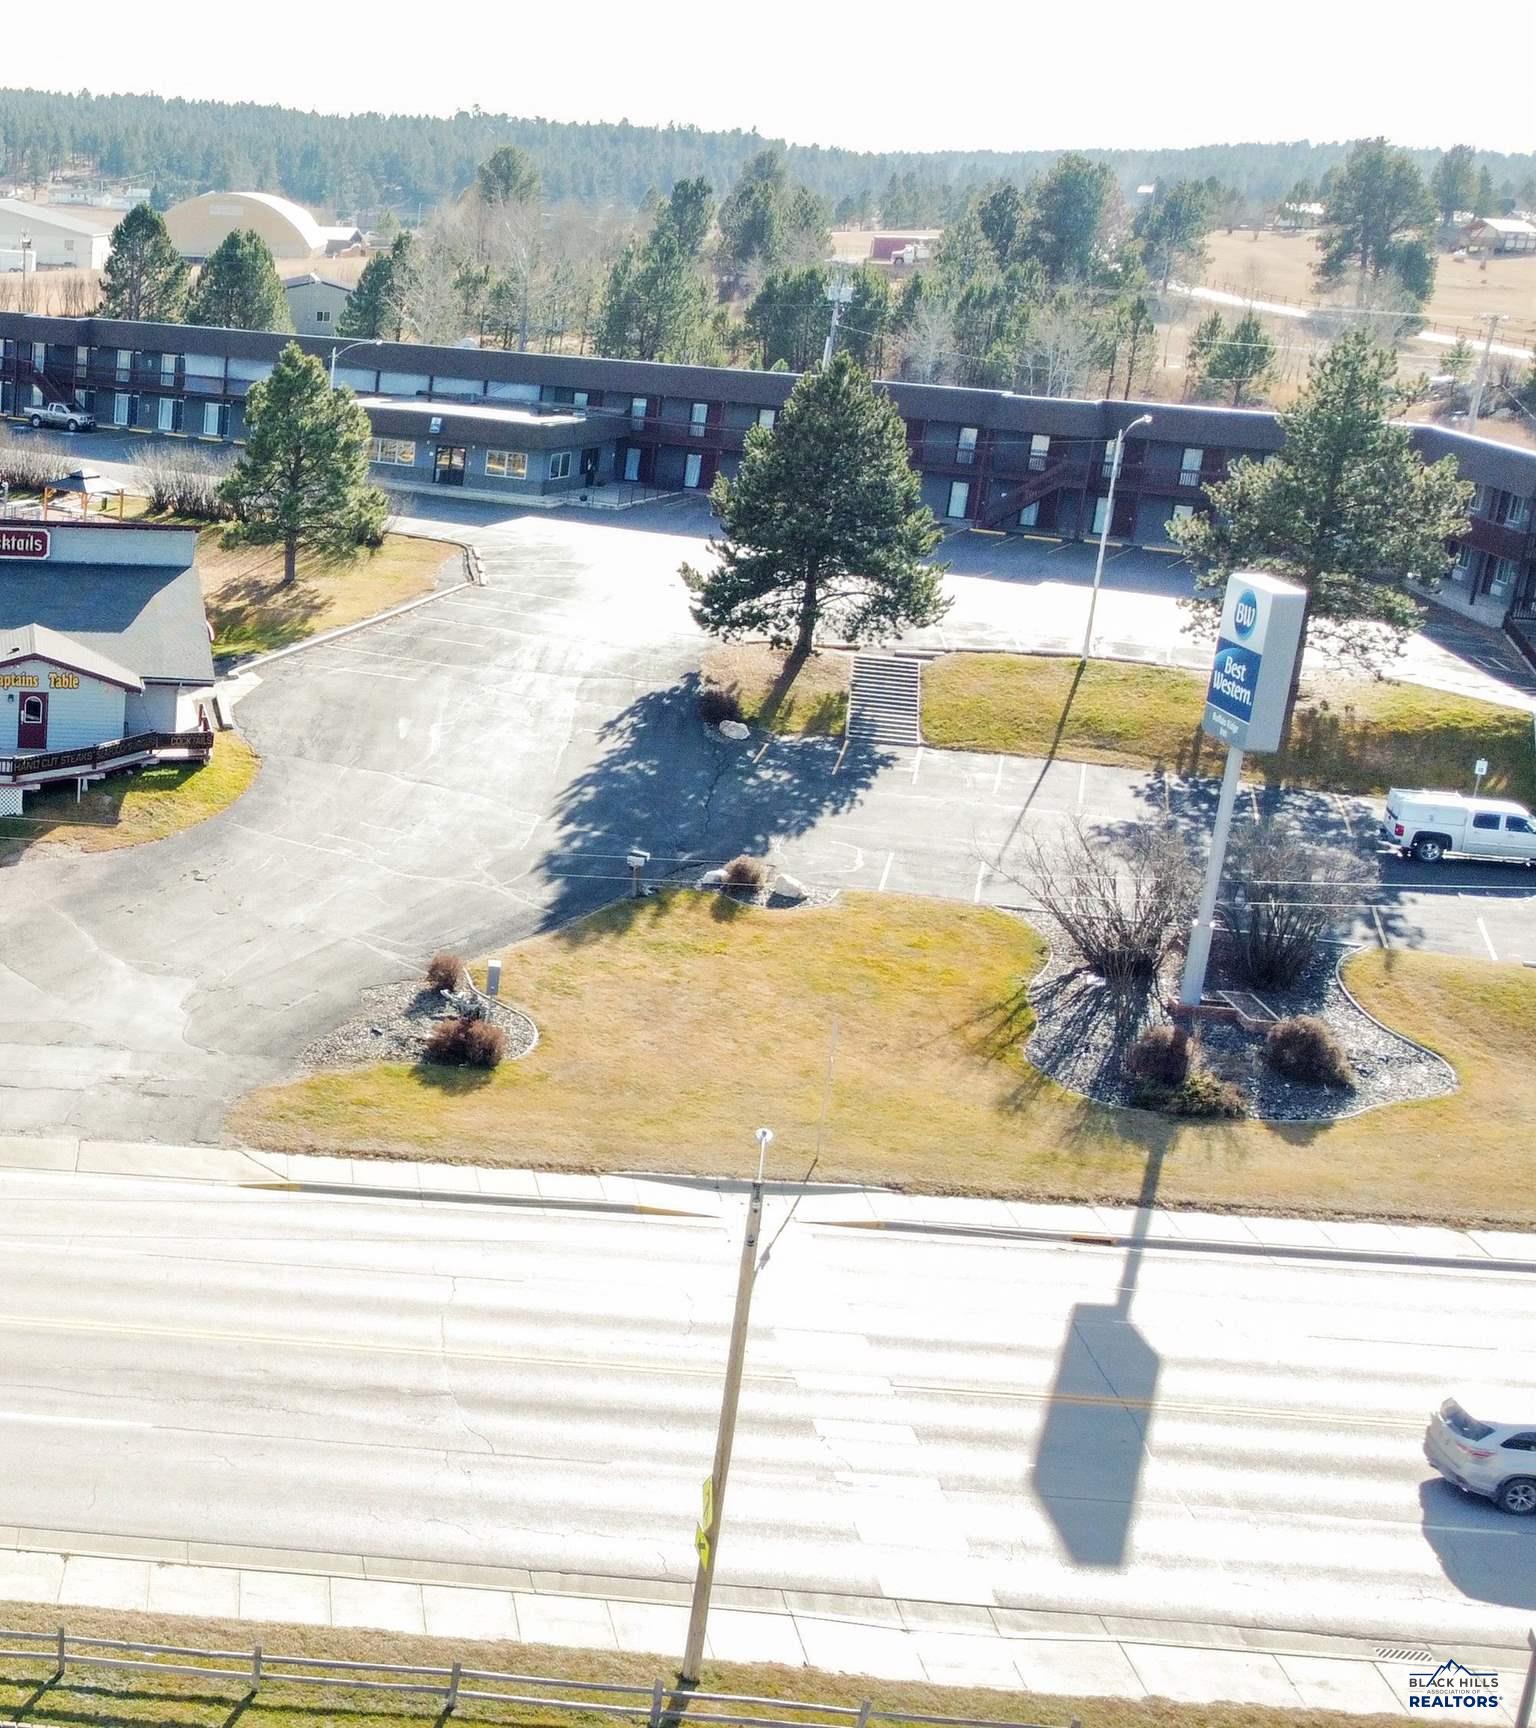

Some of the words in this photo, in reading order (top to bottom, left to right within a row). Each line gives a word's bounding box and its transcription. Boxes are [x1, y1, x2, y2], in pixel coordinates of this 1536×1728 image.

[1235, 602, 1256, 628] BW
[48, 672, 80, 689] Table
[1224, 655, 1247, 682] Best
